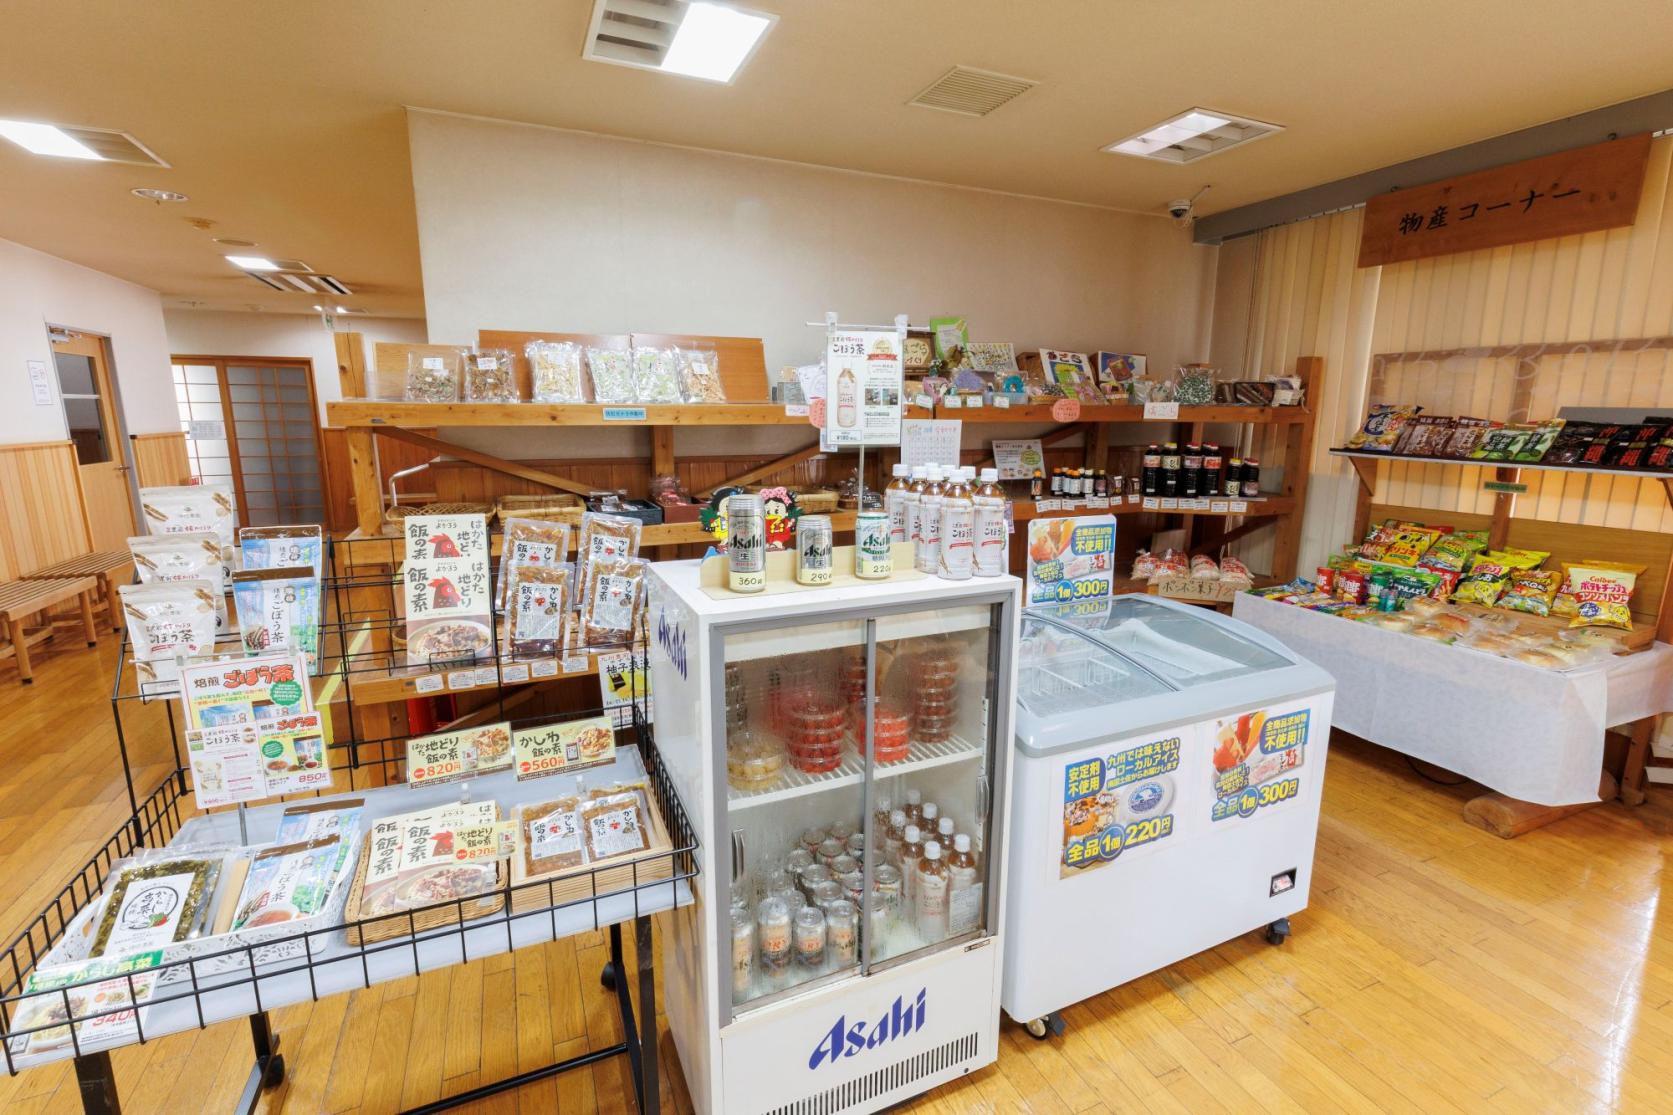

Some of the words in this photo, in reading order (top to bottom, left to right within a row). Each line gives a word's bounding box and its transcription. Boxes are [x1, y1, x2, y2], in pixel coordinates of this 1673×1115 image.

[1399, 189, 1581, 235] 物産コーナー
[457, 531, 471, 557] 地ど
[407, 567, 429, 613] 飯の素
[457, 573, 471, 609] 地どり
[471, 561, 485, 594] はかた
[425, 736, 459, 752] 地どり
[519, 731, 560, 748] かしわ
[532, 742, 562, 757] 飯の素
[426, 747, 458, 764] 飯の素
[427, 761, 460, 776] 820円
[532, 756, 565, 770] 560円
[1117, 749, 1178, 777] ローカルアイス
[1069, 778, 1100, 798] 不使用
[1259, 780, 1298, 805] 300円
[407, 826, 431, 863] 飯の素
[1068, 840, 1099, 864] 全品
[1103, 835, 1121, 853] 1個
[1124, 815, 1171, 846] 220円
[374, 836, 398, 875] 飯の素
[809, 987, 927, 1071] Asahi
